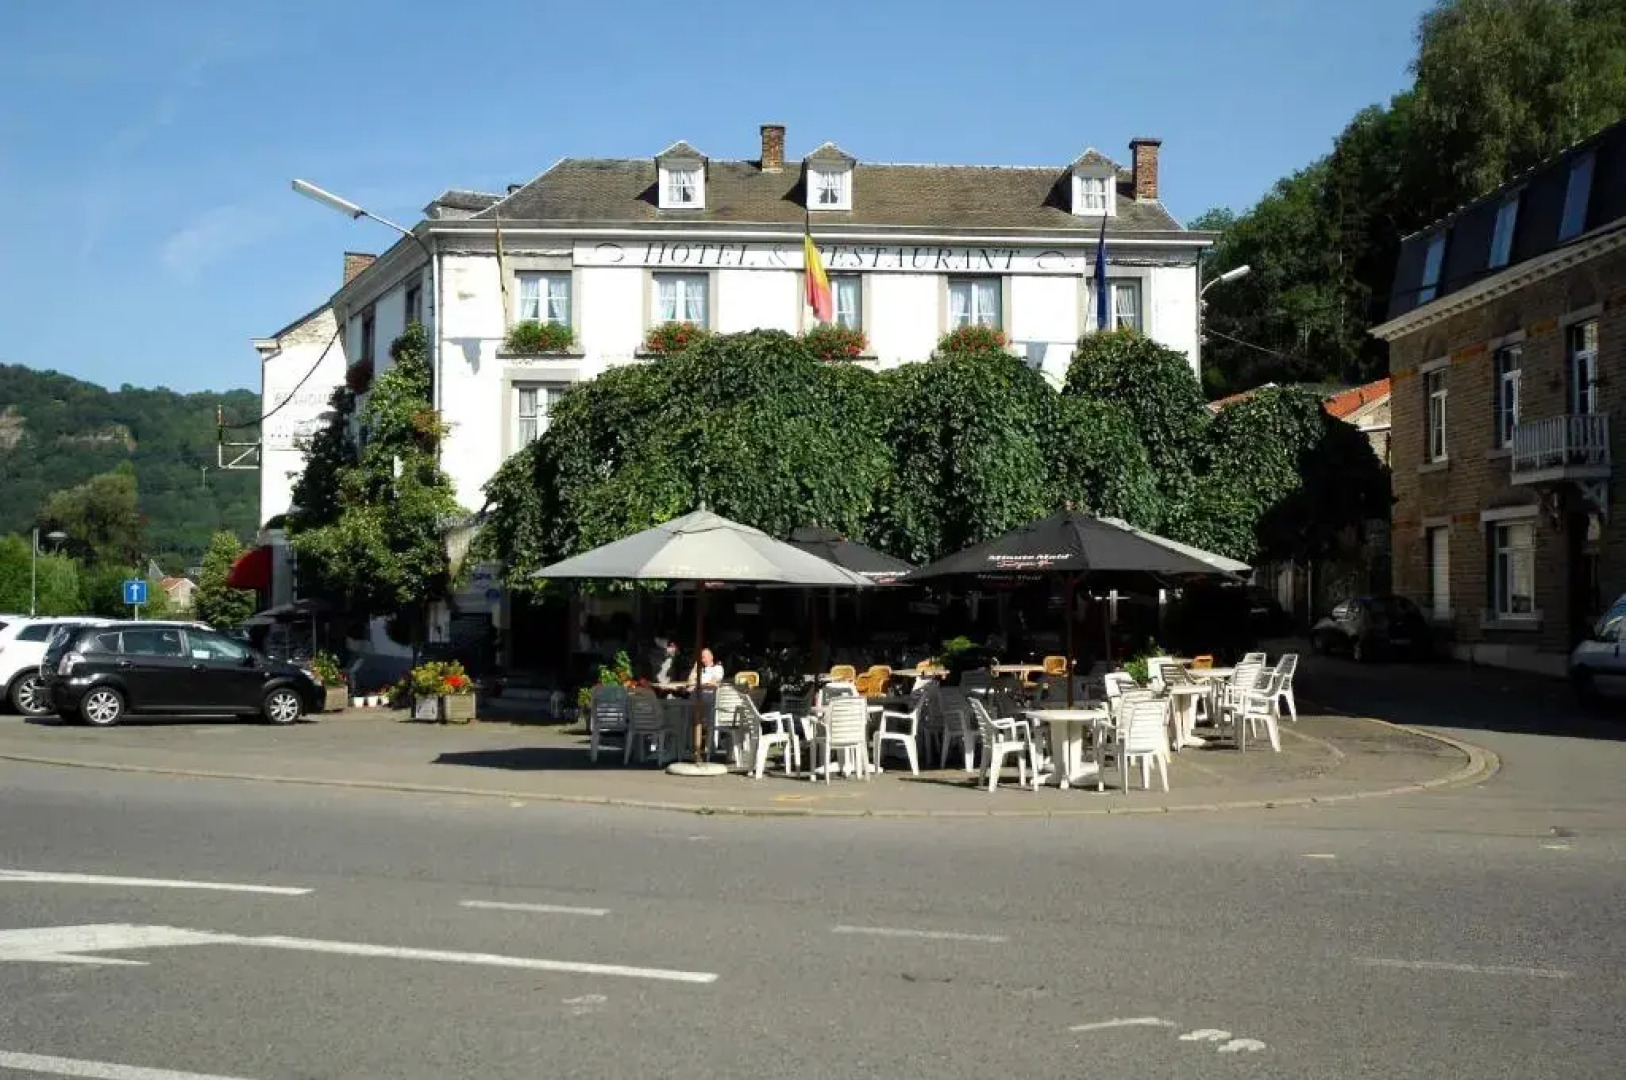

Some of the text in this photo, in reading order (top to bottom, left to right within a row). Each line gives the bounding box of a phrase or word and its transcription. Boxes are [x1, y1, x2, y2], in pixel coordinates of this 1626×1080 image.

[645, 242, 1020, 269] HOTEL & ESTAURANT
